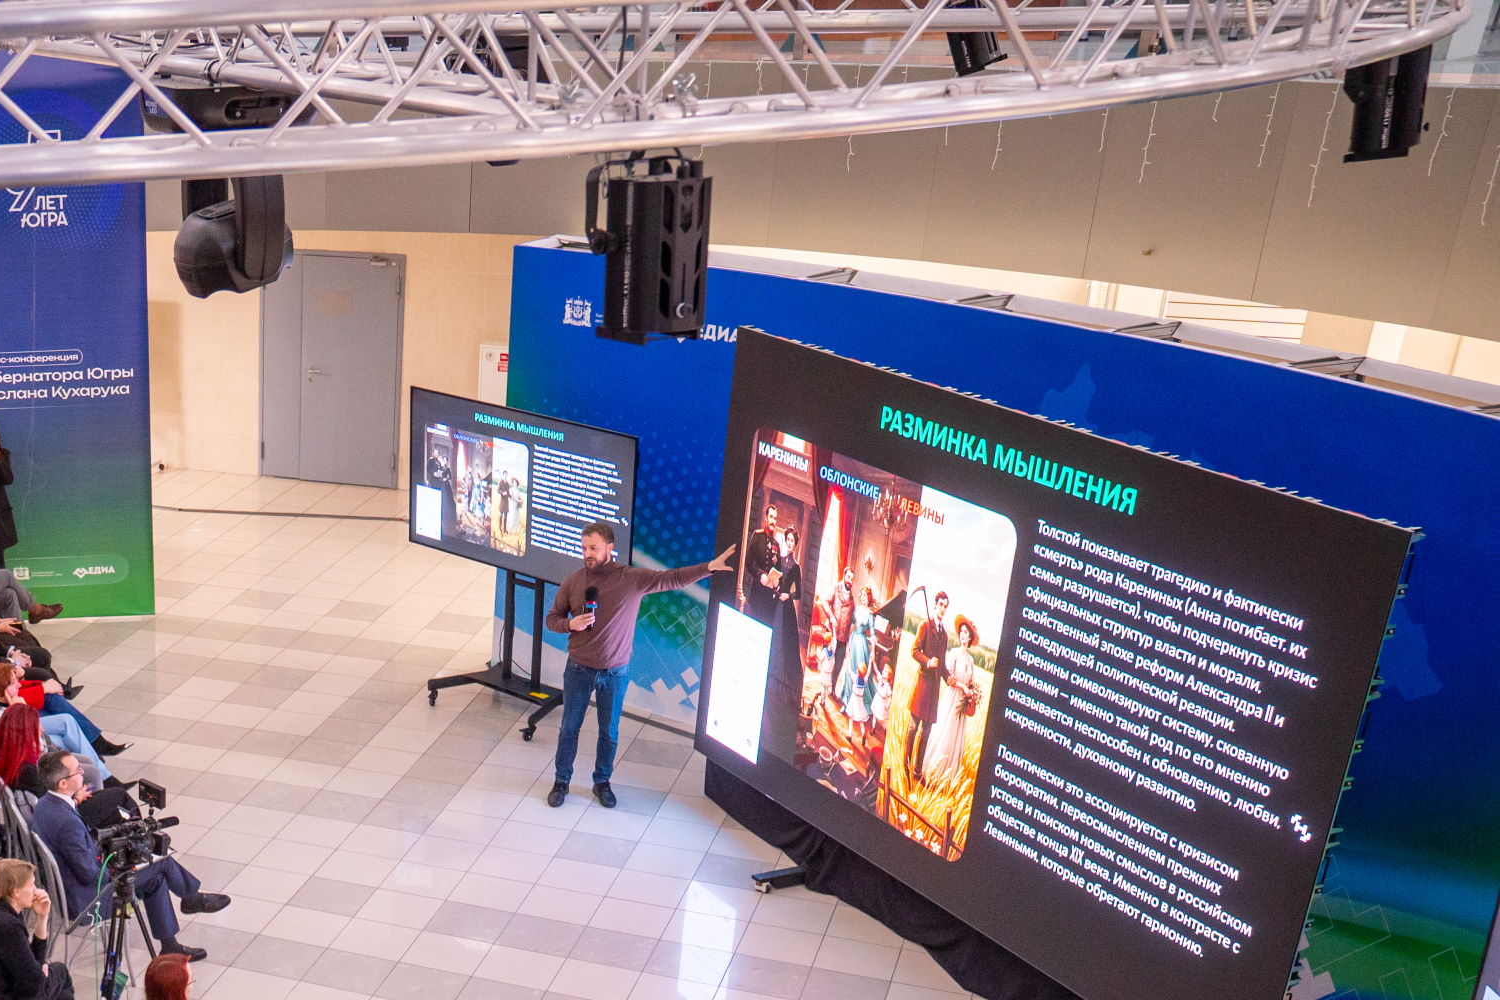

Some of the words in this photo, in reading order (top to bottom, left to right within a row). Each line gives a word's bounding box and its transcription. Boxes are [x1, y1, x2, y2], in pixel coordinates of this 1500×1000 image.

[21, 212, 68, 228] ЮГРА
[34, 194, 67, 210] ЛЕТ
[52, 385, 130, 399] Кухарука
[87, 368, 134, 379] Югры
[474, 413, 516, 431] РАЗМИНКА
[516, 422, 564, 442] МЫШЛЕНИЯ
[758, 442, 808, 472] КАРЕНИНЫ
[820, 466, 879, 499] ОБЛОНСКИЕ
[880, 406, 988, 464] РАЗМИНКА
[994, 444, 1138, 516] МЫШЛЕНИЯ
[900, 497, 944, 525] ЛЕВИНЫ
[1029, 565, 1062, 586] семья
[1062, 578, 1141, 619] разрушается),
[1143, 609, 1181, 634] чтобы
[1182, 625, 1265, 668] подчеркнуть
[1267, 659, 1317, 688] кризис
[1033, 543, 1083, 570] «смерть»
[1083, 563, 1113, 584] рода
[1114, 571, 1183, 611] Карениных
[1184, 596, 1221, 625] (Анна
[1222, 616, 1286, 652] погибает,
[1288, 642, 1307, 658] их
[1037, 519, 1080, 547] Толстой
[1080, 538, 1150, 573] показывает
[1150, 564, 1211, 595] трагедию
[1211, 587, 1222, 600] и
[1223, 588, 1303, 630] фактически
[1018, 626, 1094, 669] последующей
[1095, 660, 1178, 706] политической
[1178, 697, 1235, 732] реакции.
[1022, 606, 1099, 648] свойственный
[1100, 640, 1134, 663] эпохе
[1134, 655, 1184, 685] реформ
[1184, 674, 1263, 718] Александра
[1273, 714, 1284, 727] и
[1025, 586, 1102, 626] официальных
[1102, 618, 1153, 649] структур
[1154, 639, 1196, 665] власти
[1197, 656, 1207, 670] и
[1207, 661, 1261, 694] морали,
[1004, 707, 1072, 750] искренности,
[1072, 742, 1136, 782] духовному
[1135, 772, 1196, 811] развитию.
[1007, 688, 1073, 727] оказывается
[1073, 719, 1141, 760] неспособен
[1142, 752, 1151, 765] к
[1151, 757, 1232, 806] обновлению,
[1233, 797, 1280, 829] любви,
[1010, 667, 1058, 697] догмами
[1069, 694, 1114, 723] именно
[1115, 715, 1149, 740] такой
[1149, 732, 1173, 755] род
[1174, 743, 1191, 759] по
[1192, 752, 1214, 770] его
[1214, 762, 1270, 796] мнению
[1014, 644, 1069, 680] Каренины
[1070, 672, 1162, 722] символизируют
[1161, 714, 1213, 748] систему,
[1215, 739, 1289, 780] скованную
[990, 784, 1024, 810] устоев
[1024, 803, 1032, 815] и
[1032, 808, 1079, 841] поиском
[1079, 834, 1115, 861] новых
[1115, 854, 1167, 889] смыслов
[1167, 882, 1176, 894] в
[1176, 887, 1252, 937] российском
[994, 763, 1058, 809] бюрократии,
[1060, 800, 1165, 865] переосмыслением
[1166, 858, 1222, 895] прежних
[997, 743, 1064, 789] Политически
[1064, 781, 1083, 798] это
[1084, 792, 1168, 843] ассоциируется
[1169, 836, 1177, 848] с
[1177, 840, 1239, 881] кризисом
[983, 820, 1038, 863] Левиными,
[1040, 854, 1085, 888] которые
[1085, 881, 1140, 919] обретают
[1140, 912, 1203, 957] гармонию.
[987, 804, 1036, 838] обществе
[1036, 831, 1068, 857] конца
[1068, 844, 1084, 866] XIX
[1083, 858, 1110, 881] века.
[1112, 871, 1159, 907] Именно
[1160, 901, 1168, 913] в
[1169, 906, 1231, 948] контрасте
[1232, 942, 1240, 953] с
